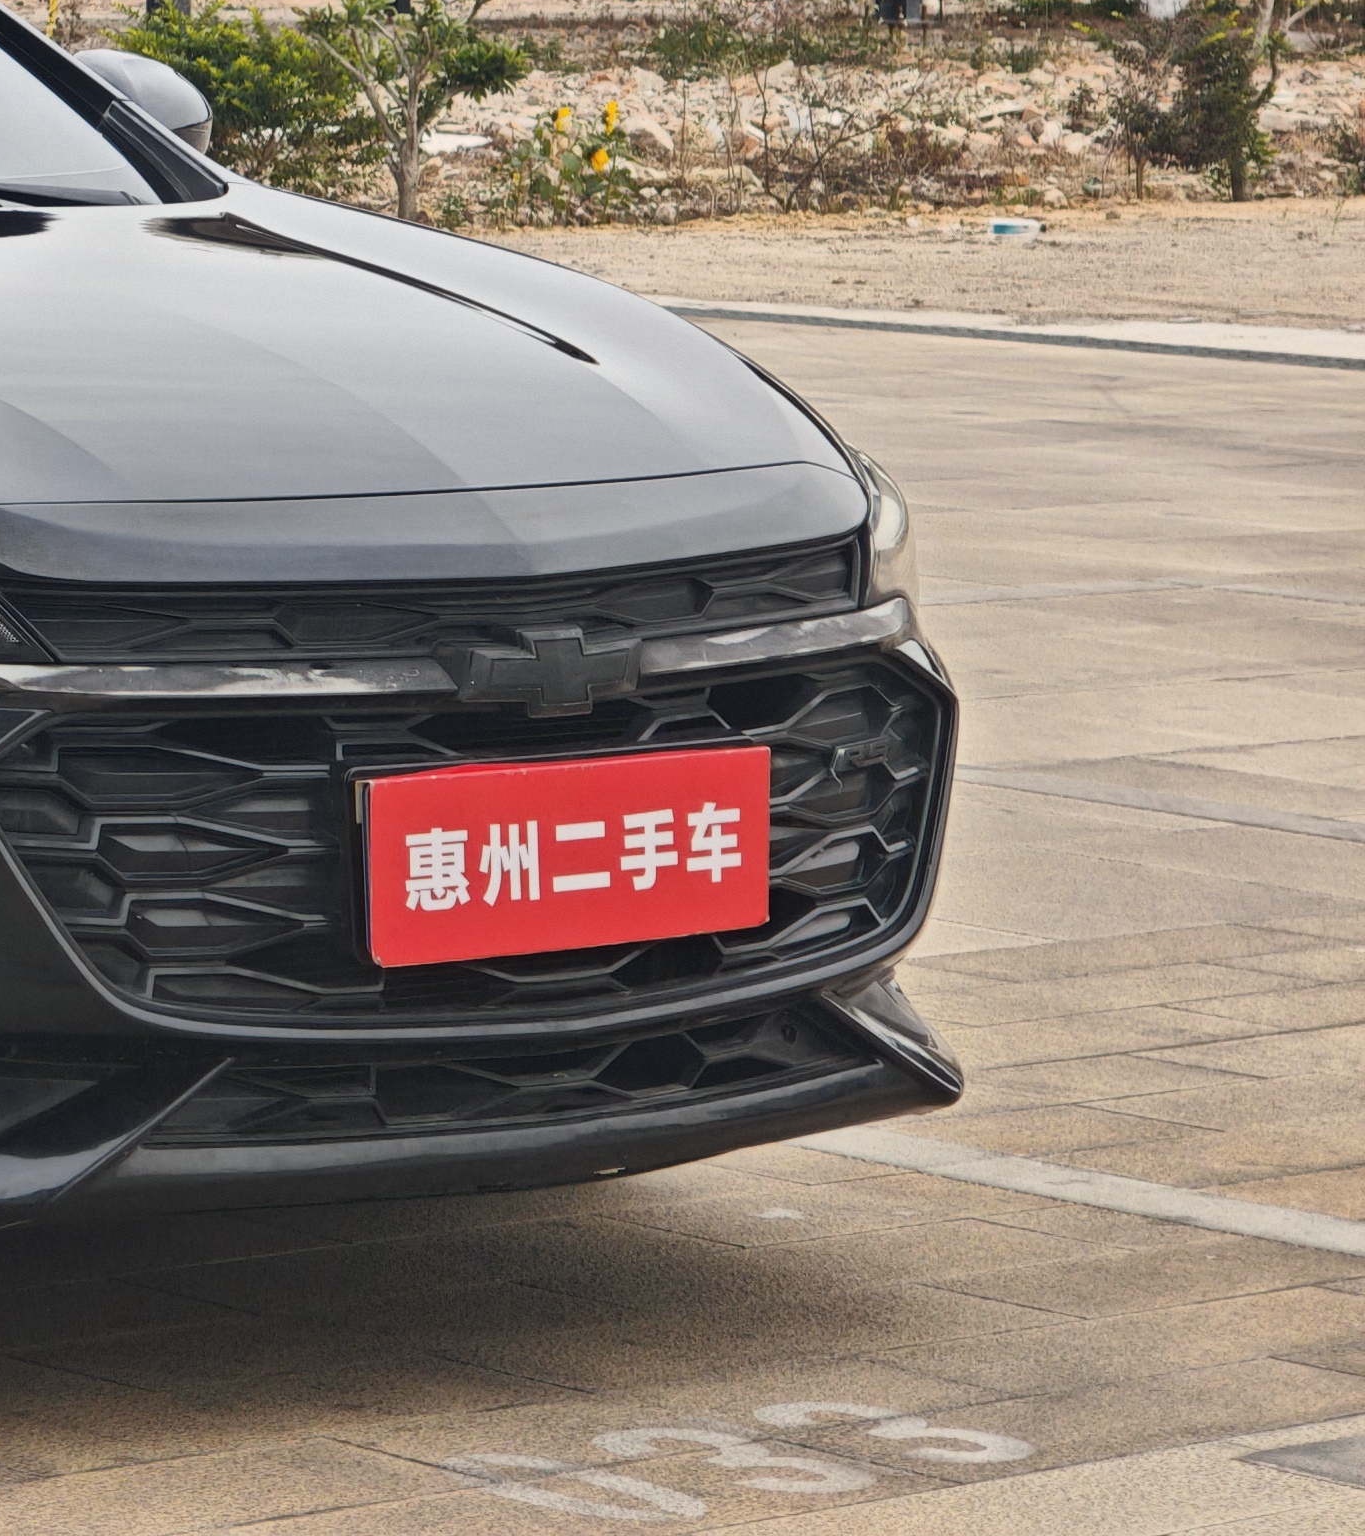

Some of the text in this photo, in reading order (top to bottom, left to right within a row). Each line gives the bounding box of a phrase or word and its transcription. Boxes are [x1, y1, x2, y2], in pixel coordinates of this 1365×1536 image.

[404, 802, 742, 913] 惠州二手车
[437, 1401, 1038, 1522] 033
